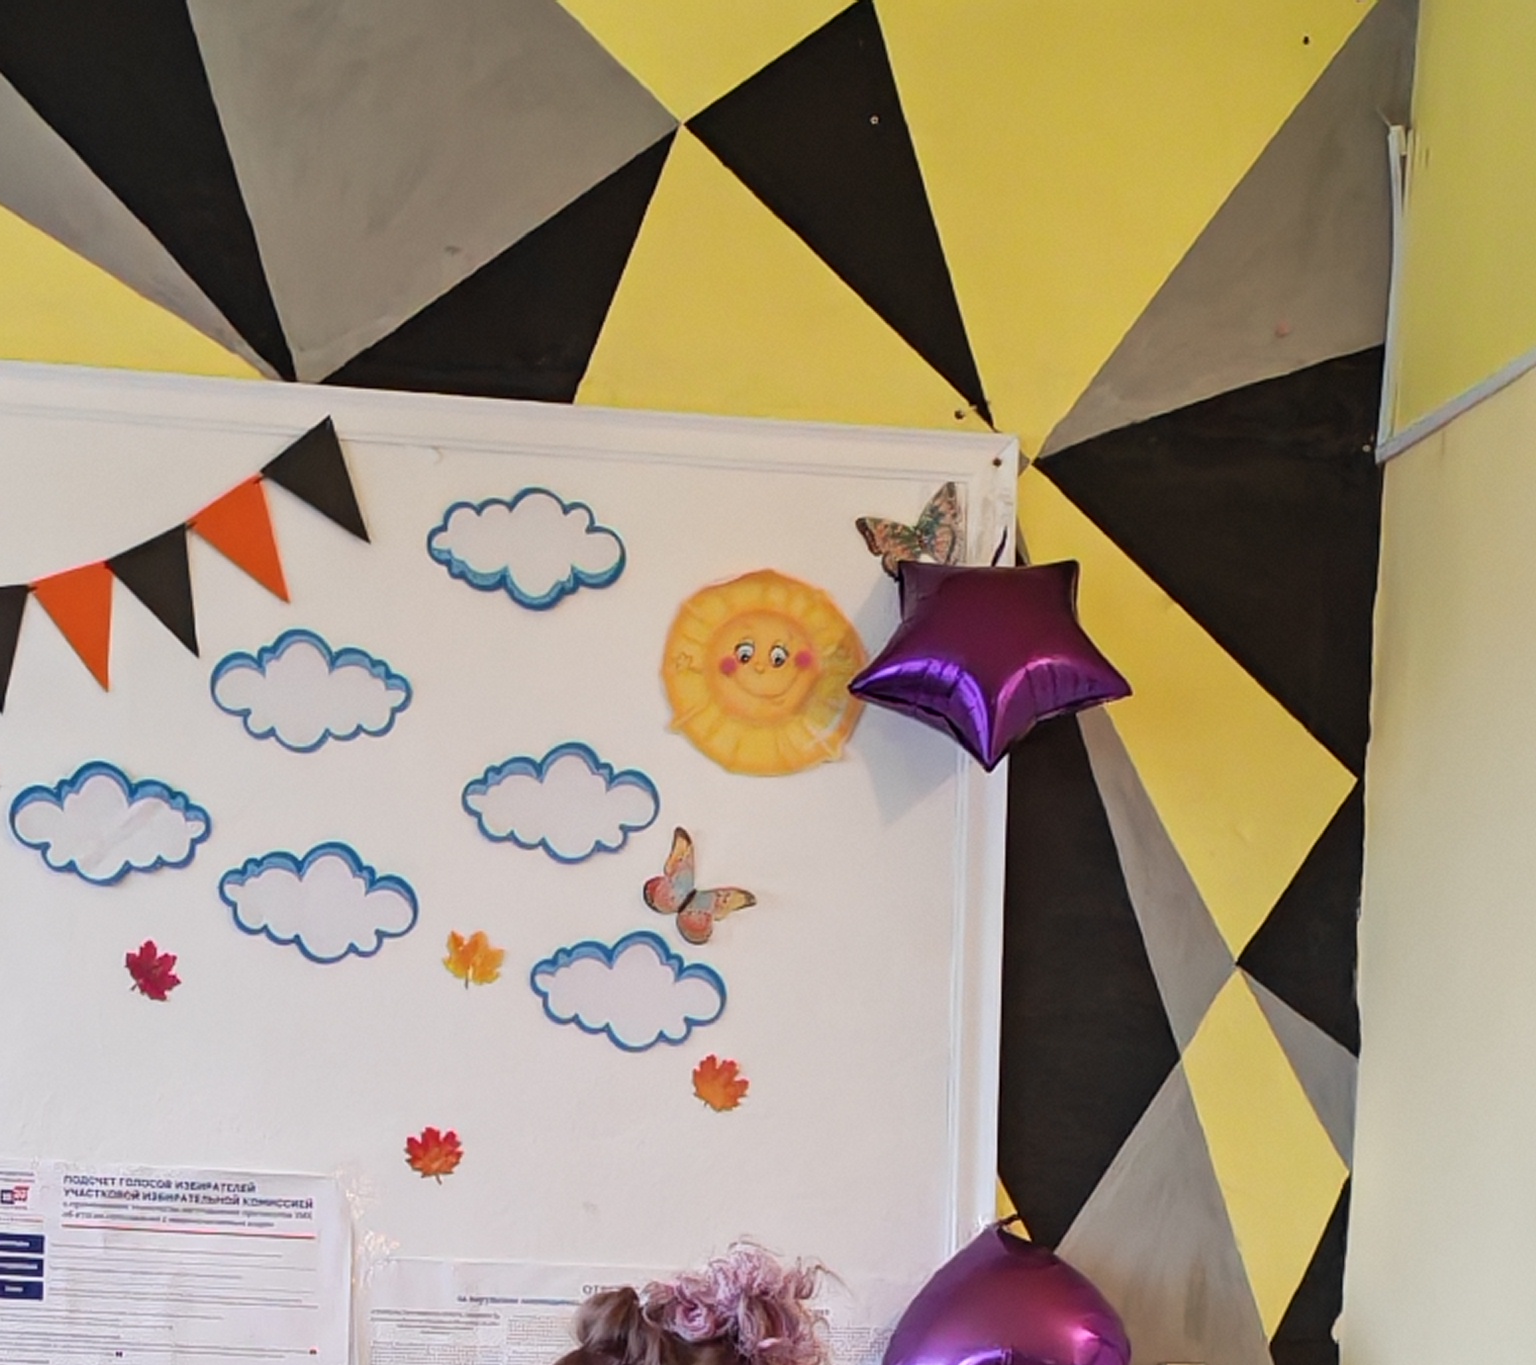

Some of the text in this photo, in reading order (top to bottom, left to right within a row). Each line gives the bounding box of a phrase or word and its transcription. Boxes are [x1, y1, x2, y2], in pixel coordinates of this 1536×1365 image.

[64, 1175, 257, 1193] ПОДСЧЕТ ГОЛОСОВ ИЗБИРАТЕЛЕЙ
[64, 1189, 140, 1201] УЧАСТКОВОЙ
[143, 1191, 240, 1206] ИЗБИРАТЕЛЬНОЙ
[243, 1198, 314, 1210] КОМИССИЕЙ
